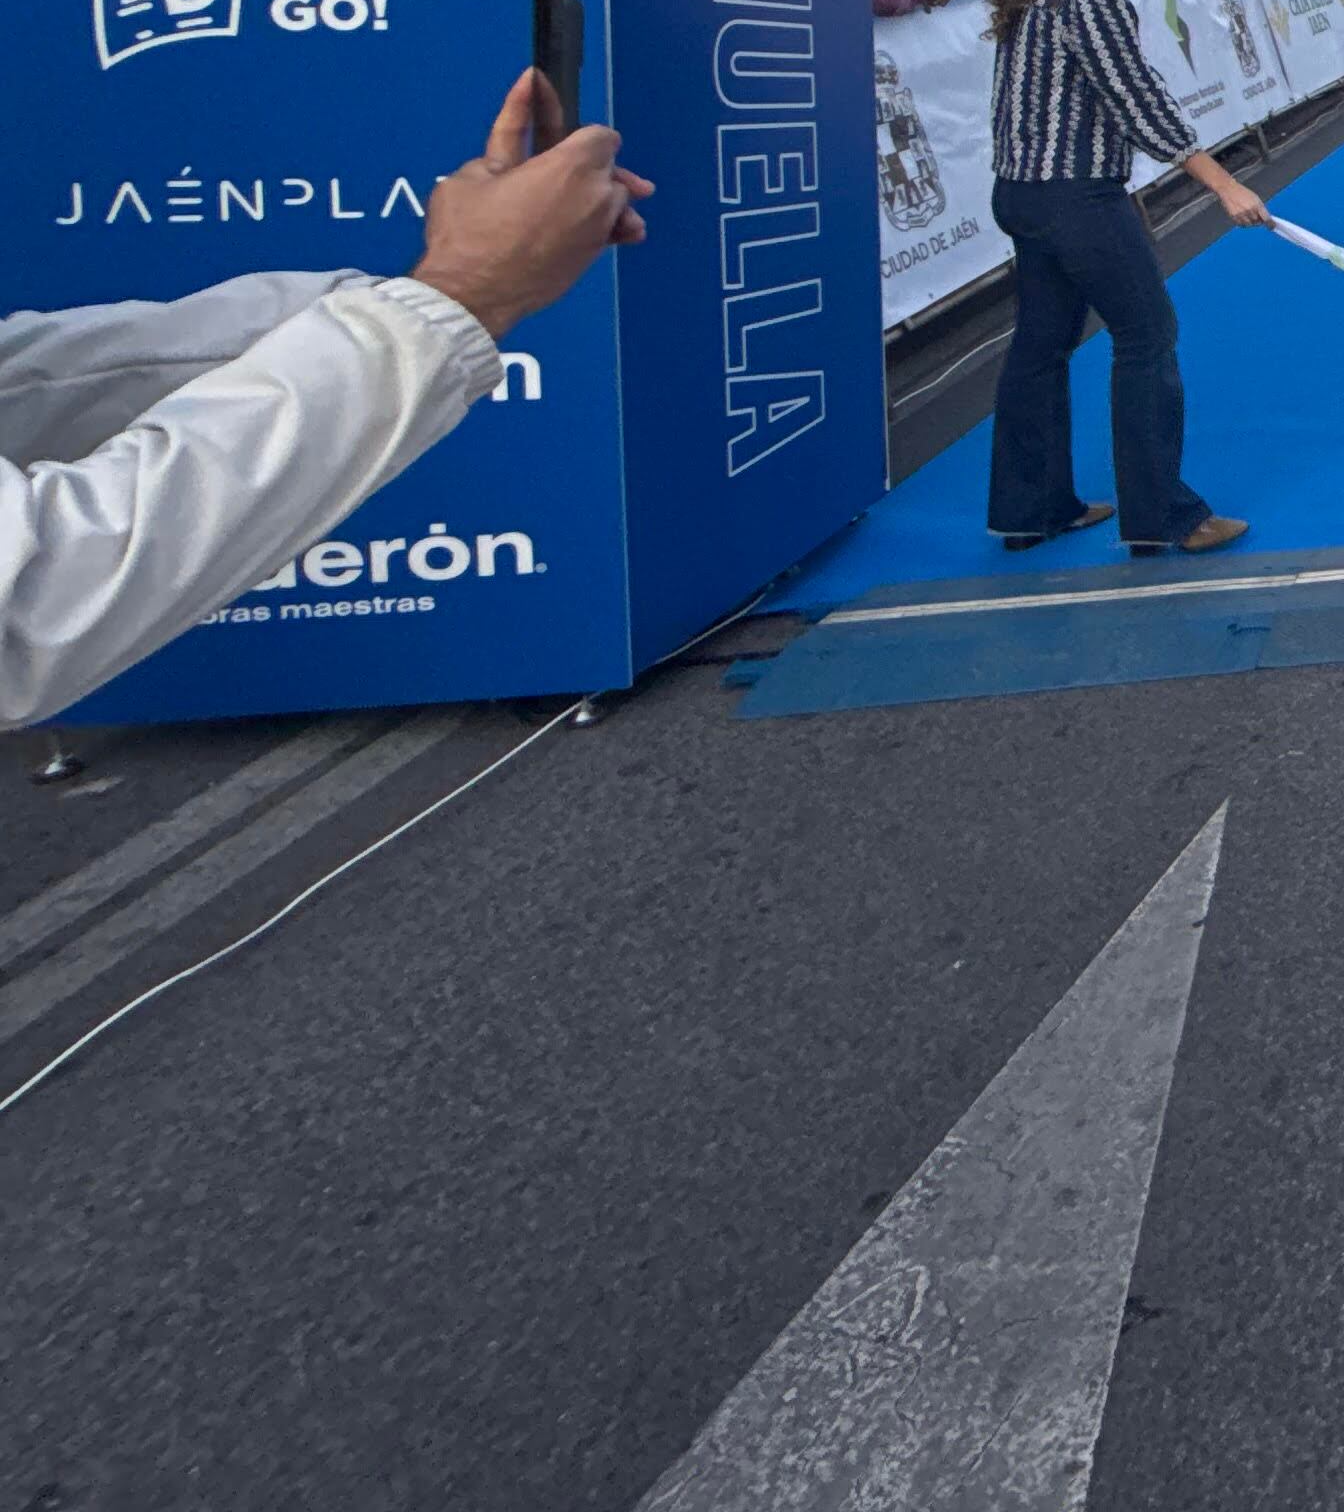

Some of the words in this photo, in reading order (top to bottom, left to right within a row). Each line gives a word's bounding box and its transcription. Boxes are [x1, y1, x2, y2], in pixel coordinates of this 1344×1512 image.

[56, 166, 447, 226] JAÉNPLA
[880, 242, 929, 278] CIUDAD
[929, 232, 948, 255] DE
[280, 595, 435, 619] maestras
